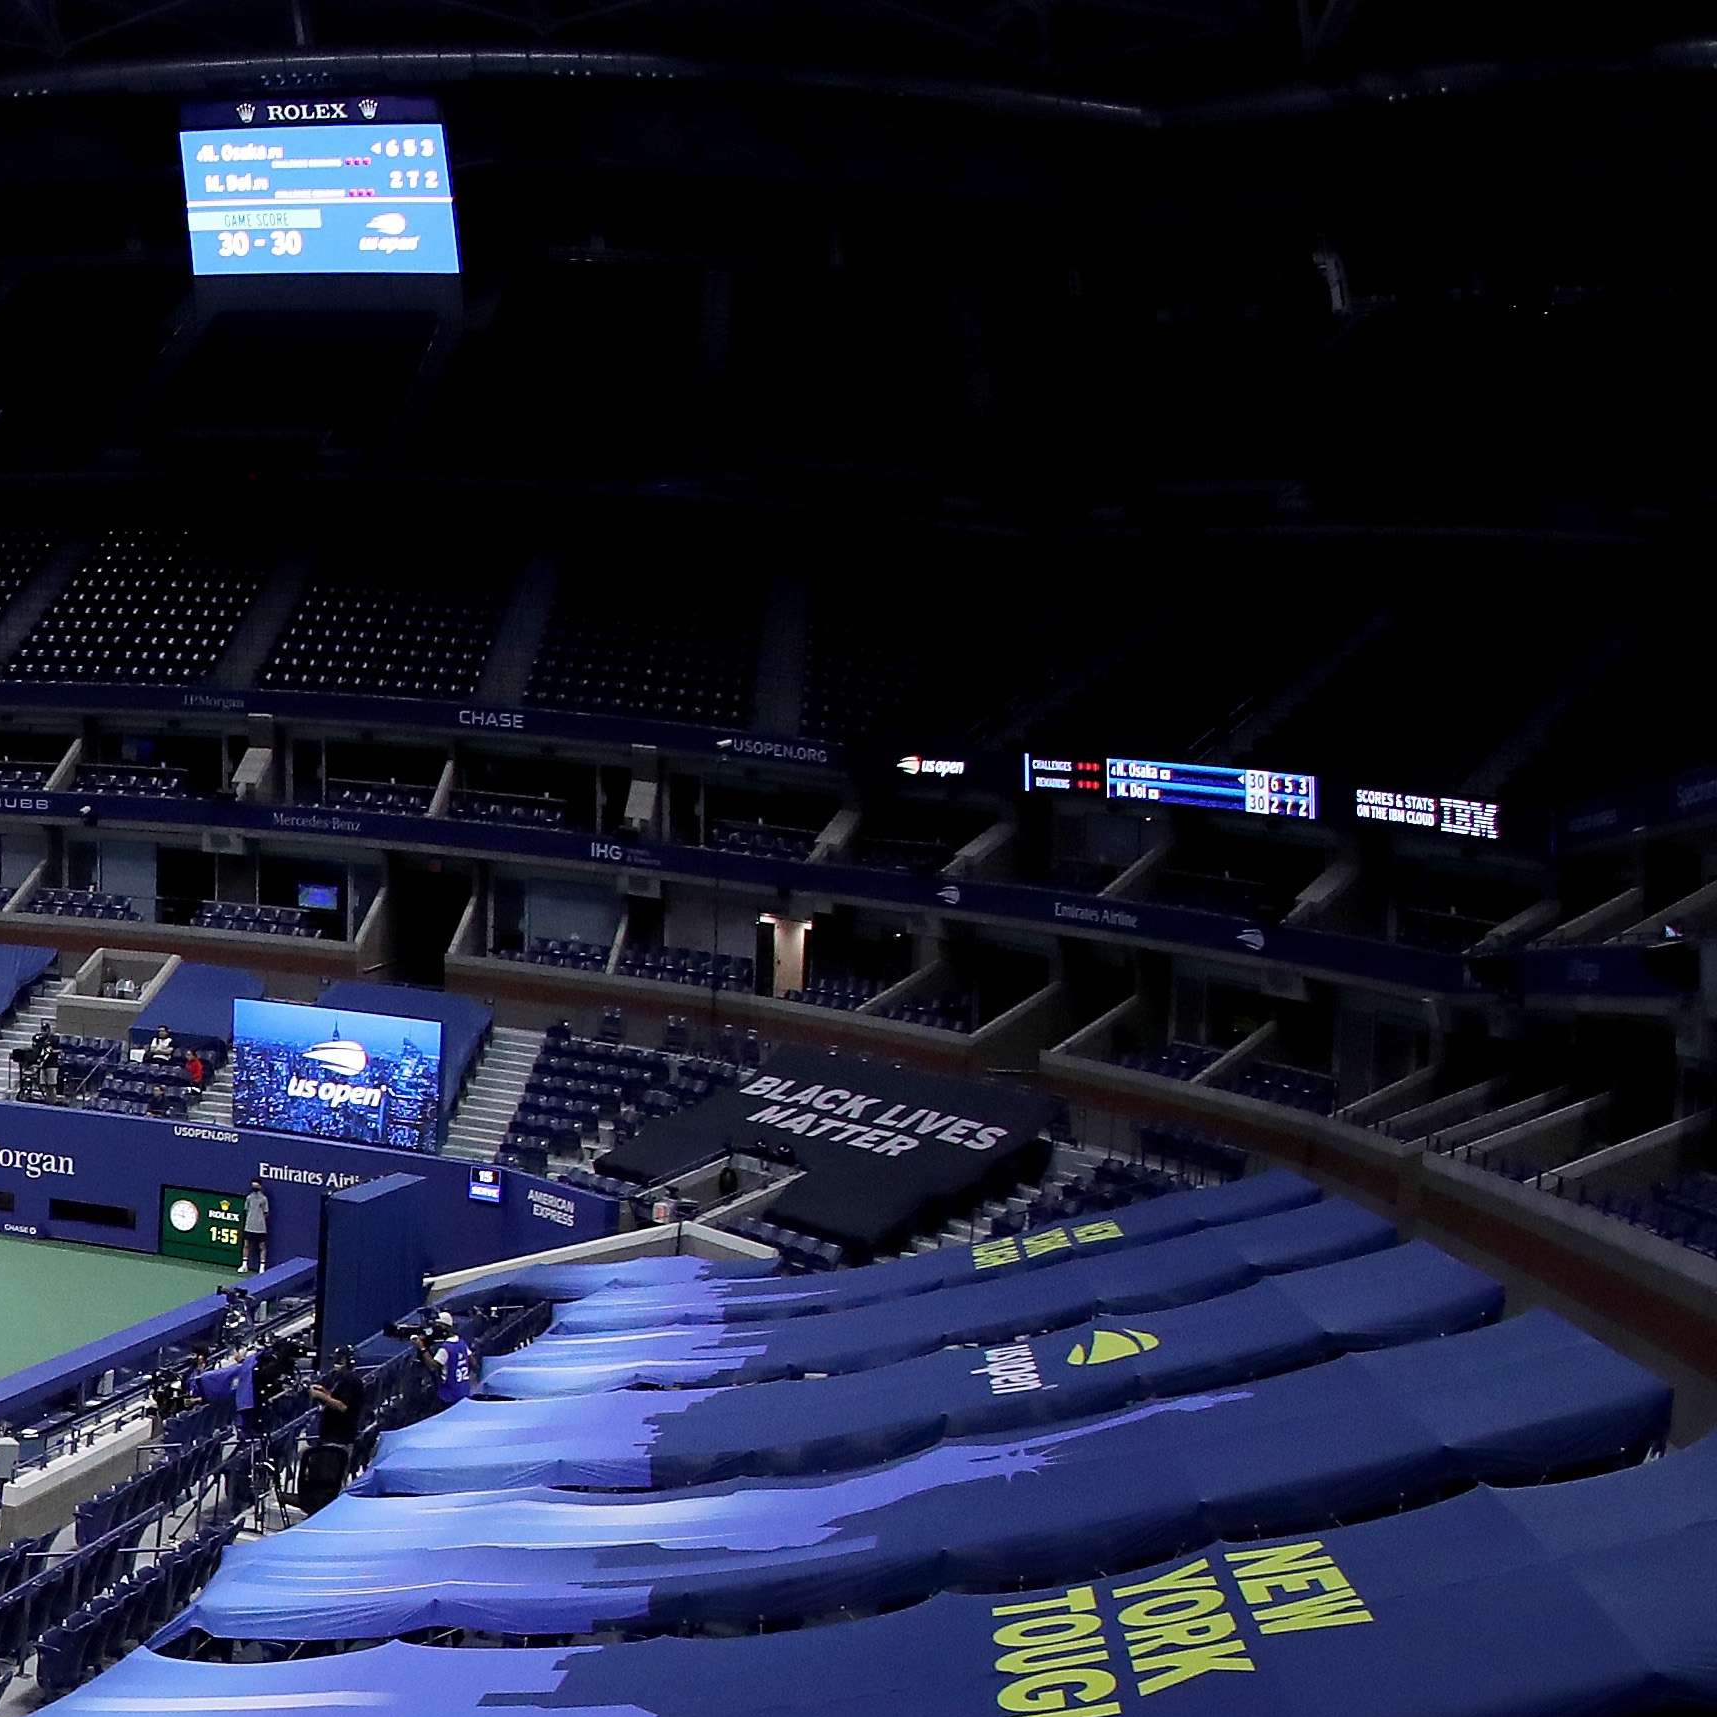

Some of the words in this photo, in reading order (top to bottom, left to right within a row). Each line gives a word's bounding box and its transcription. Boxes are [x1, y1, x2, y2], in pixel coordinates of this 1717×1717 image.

[267, 103, 348, 122] ROLEX
[224, 214, 253, 228] GAME
[256, 212, 289, 227] SCORE
[217, 230, 250, 257] 30
[270, 230, 302, 256] 30
[459, 710, 525, 729] CHASE
[733, 738, 828, 764] USOPEN.ORG
[921, 760, 935, 773] us
[934, 760, 964, 777] open
[1116, 762, 1127, 777] N.
[1128, 762, 1158, 779] Osaka
[1116, 782, 1128, 797] M.
[1130, 782, 1147, 798] Doi
[1249, 773, 1265, 788] 30
[1270, 776, 1279, 792] 6
[1284, 777, 1293, 793] 5
[1298, 778, 1307, 795] 3
[1249, 795, 1265, 810] 30
[1270, 797, 1279, 813] 2
[1284, 798, 1293, 815] 7
[1298, 800, 1307, 817] 2
[1356, 789, 1394, 806] SCORES
[1395, 794, 1404, 809] &
[1405, 795, 1435, 812] STATS
[1356, 804, 1369, 818] ON
[1371, 805, 1388, 821] THE
[1388, 807, 1404, 823] IBM
[1406, 809, 1435, 827] CLOUD
[1440, 797, 1499, 839] IBM
[590, 842, 623, 861] IHG
[287, 1075, 318, 1098] us
[318, 1080, 382, 1108] open
[738, 1074, 884, 1119] BLACK
[871, 1104, 1009, 1151] LIVES
[174, 1125, 239, 1143] USOPEN.ORG
[745, 1105, 920, 1157] MATTER
[259, 1163, 323, 1186] Emirates
[479, 1170, 493, 1183] 15
[527, 1188, 575, 1214] AMERICAN
[208, 1210, 240, 1222] ROLEX
[532, 1203, 575, 1227] EXPRESS
[4, 1224, 29, 1234] CHASE
[210, 1227, 238, 1245] 1:55
[455, 1367, 469, 1383] 92
[1225, 1540, 1374, 1636] NEW
[1111, 1558, 1256, 1696] YORK
